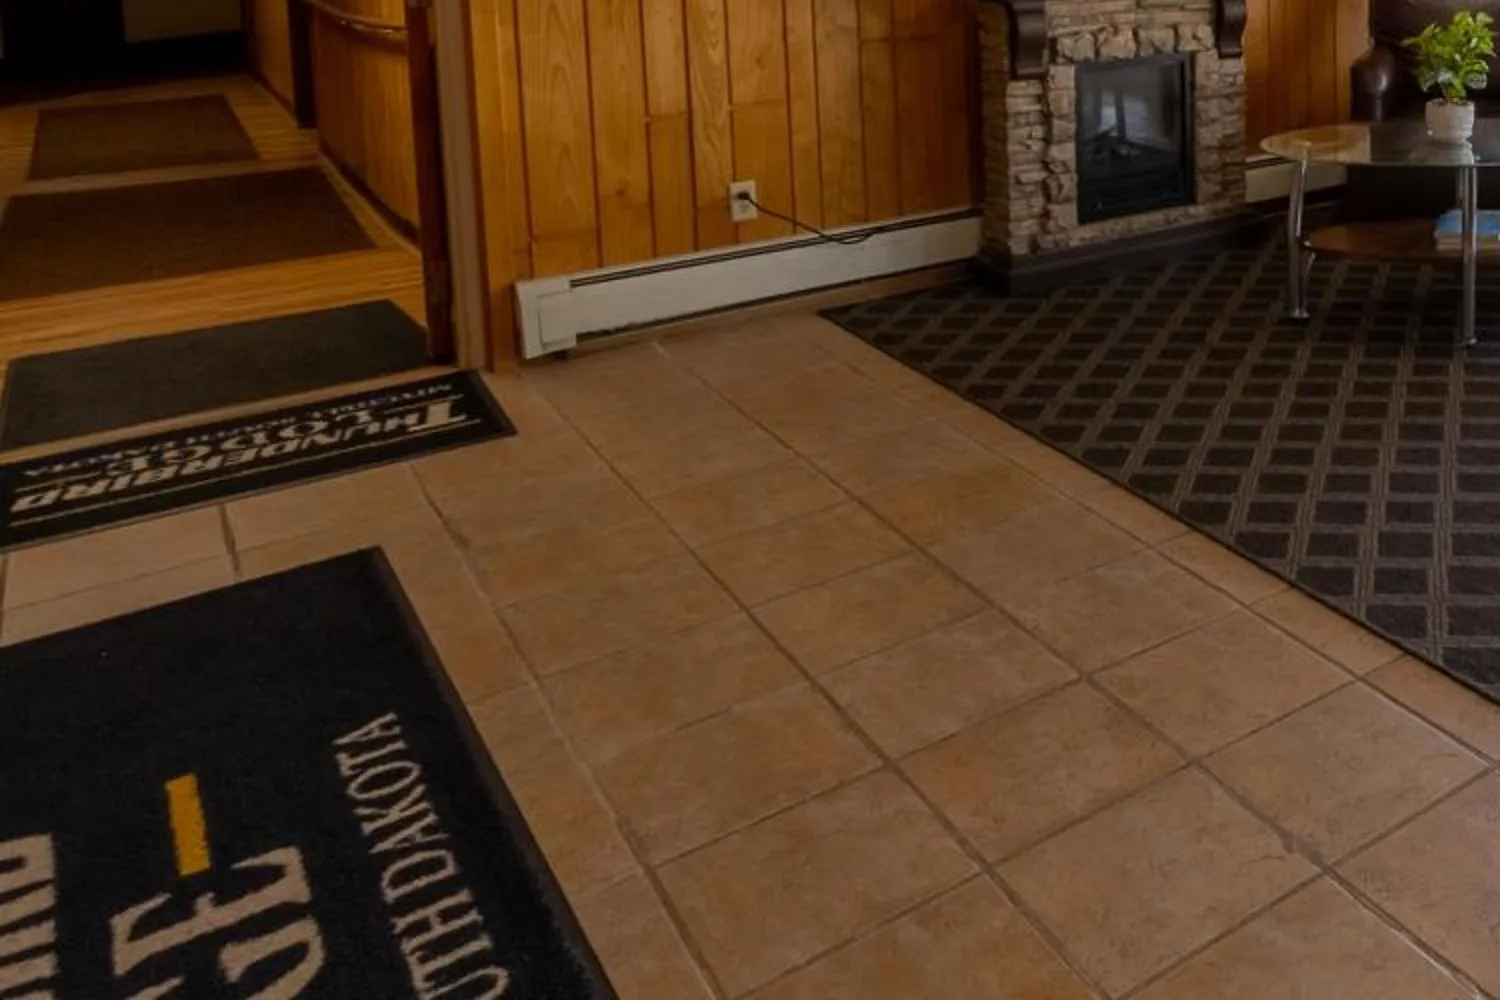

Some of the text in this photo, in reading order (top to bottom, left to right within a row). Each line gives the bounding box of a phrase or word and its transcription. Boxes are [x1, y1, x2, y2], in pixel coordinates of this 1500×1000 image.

[10, 401, 467, 512] THUNDERBIRD
[105, 408, 372, 477] LODGE
[333, 713, 511, 1000] UTH DAKOTA
